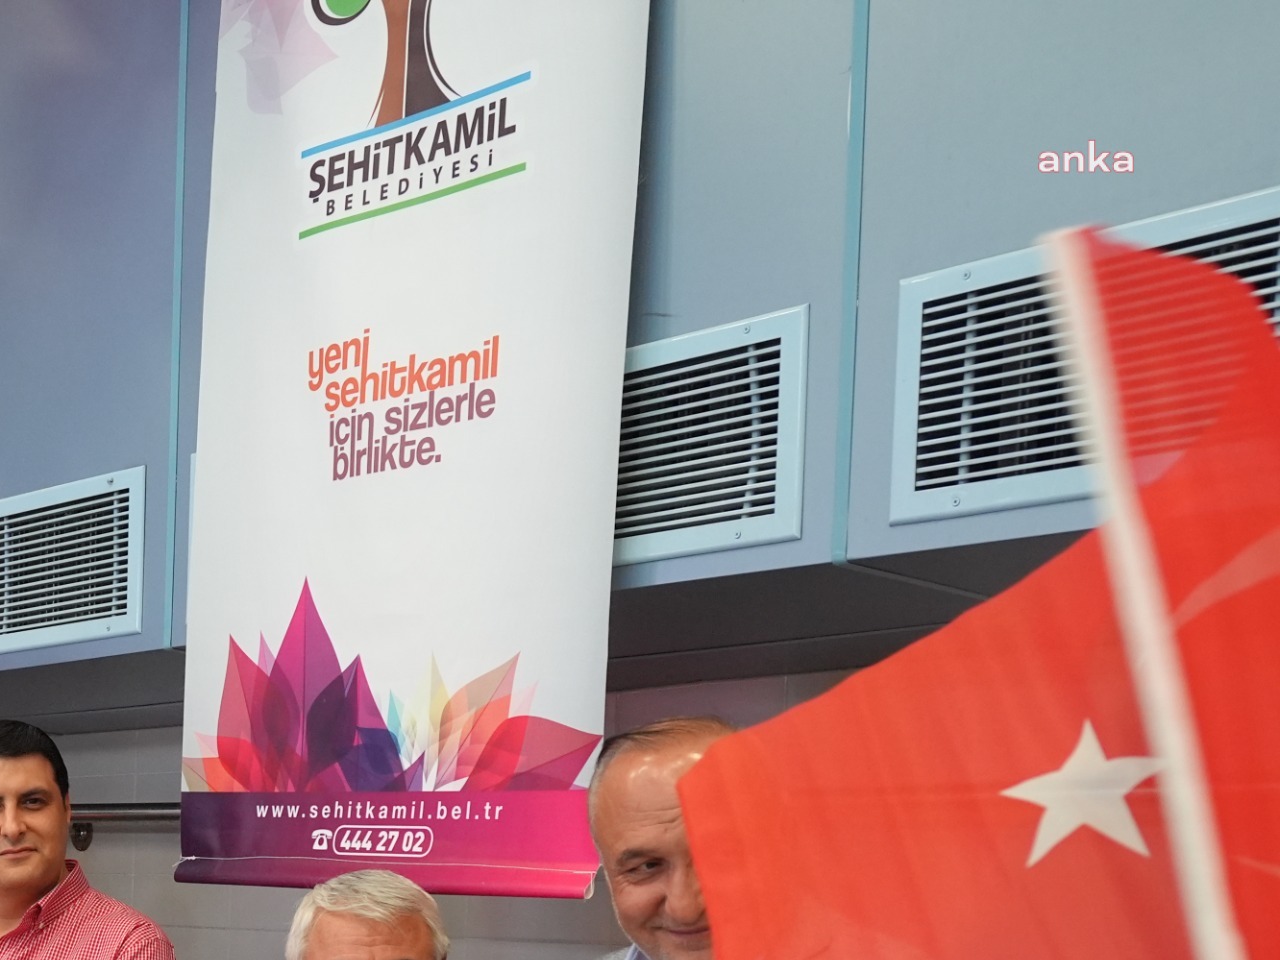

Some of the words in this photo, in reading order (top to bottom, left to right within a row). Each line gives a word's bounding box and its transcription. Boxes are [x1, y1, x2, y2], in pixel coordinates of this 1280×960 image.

[308, 328, 370, 391] yeni
[329, 408, 375, 448] için
[383, 382, 496, 436] sizlerle
[332, 434, 442, 481] birlikte.
[255, 800, 504, 820] www.sehitkamil.bel.tr
[339, 830, 373, 851] 444
[376, 830, 400, 852] 27
[402, 831, 426, 853] 02
